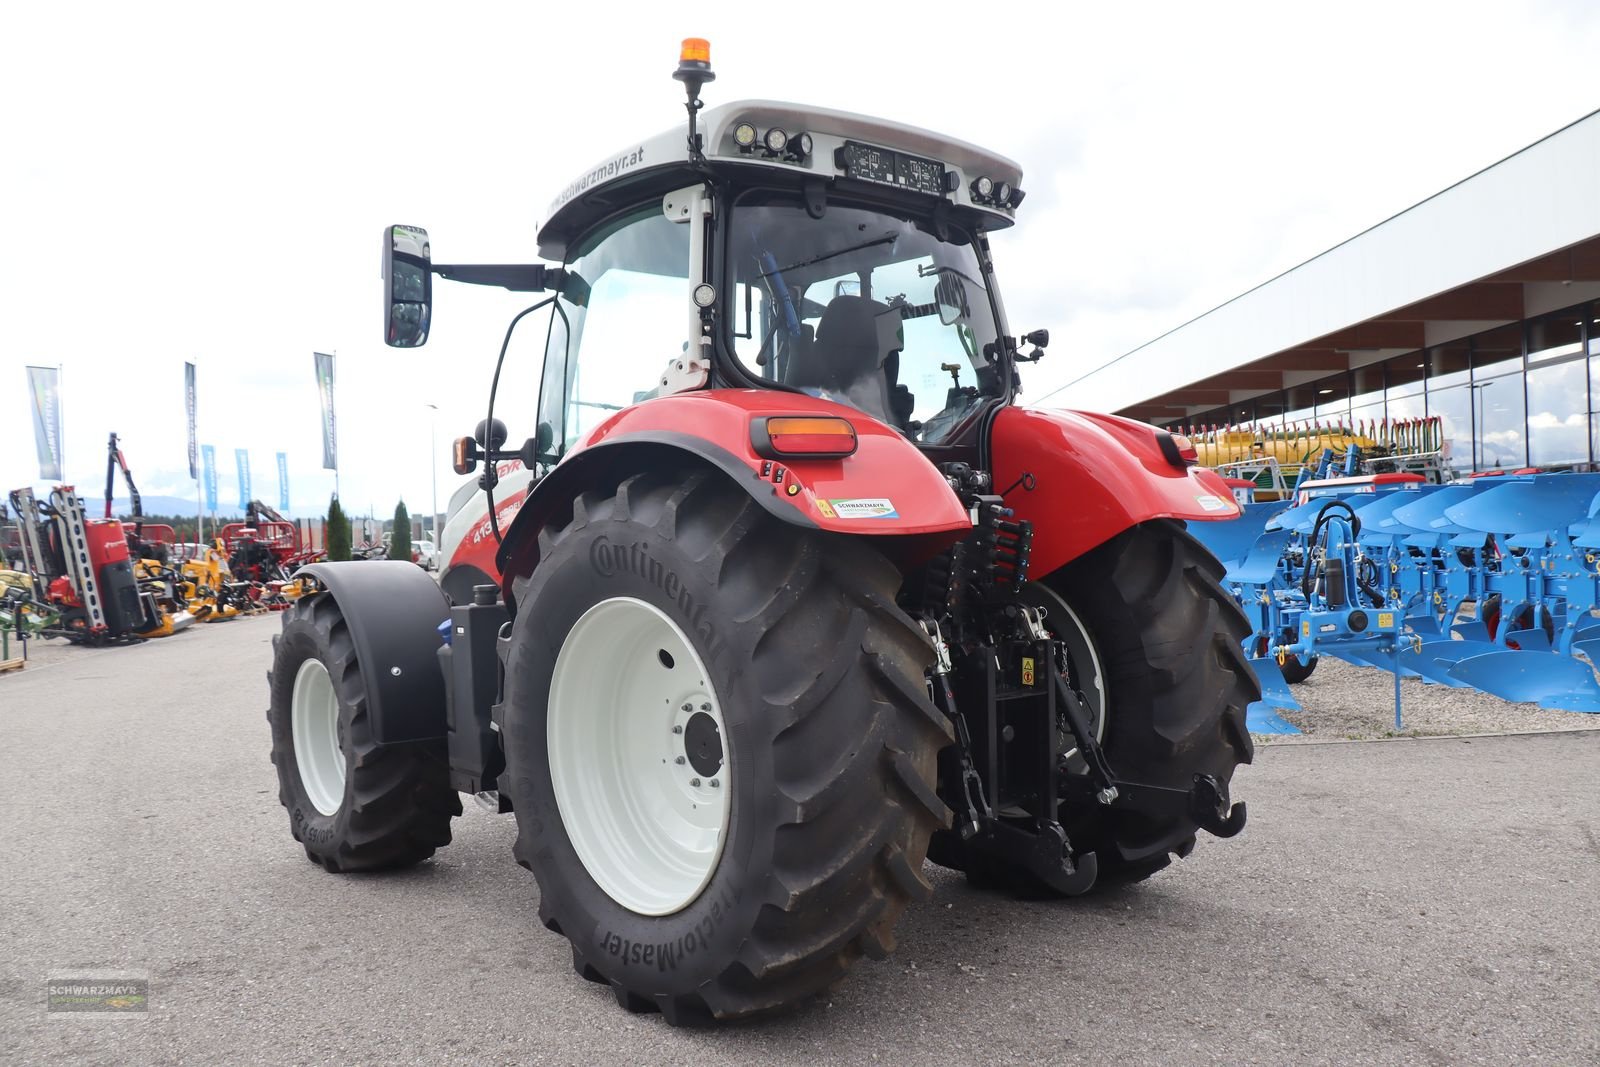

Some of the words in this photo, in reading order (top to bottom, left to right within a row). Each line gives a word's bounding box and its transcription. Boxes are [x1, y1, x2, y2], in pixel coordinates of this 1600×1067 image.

[547, 146, 644, 213] .schwarzmayr.at
[589, 535, 726, 661] Continental
[600, 877, 743, 973] TractorMaster
